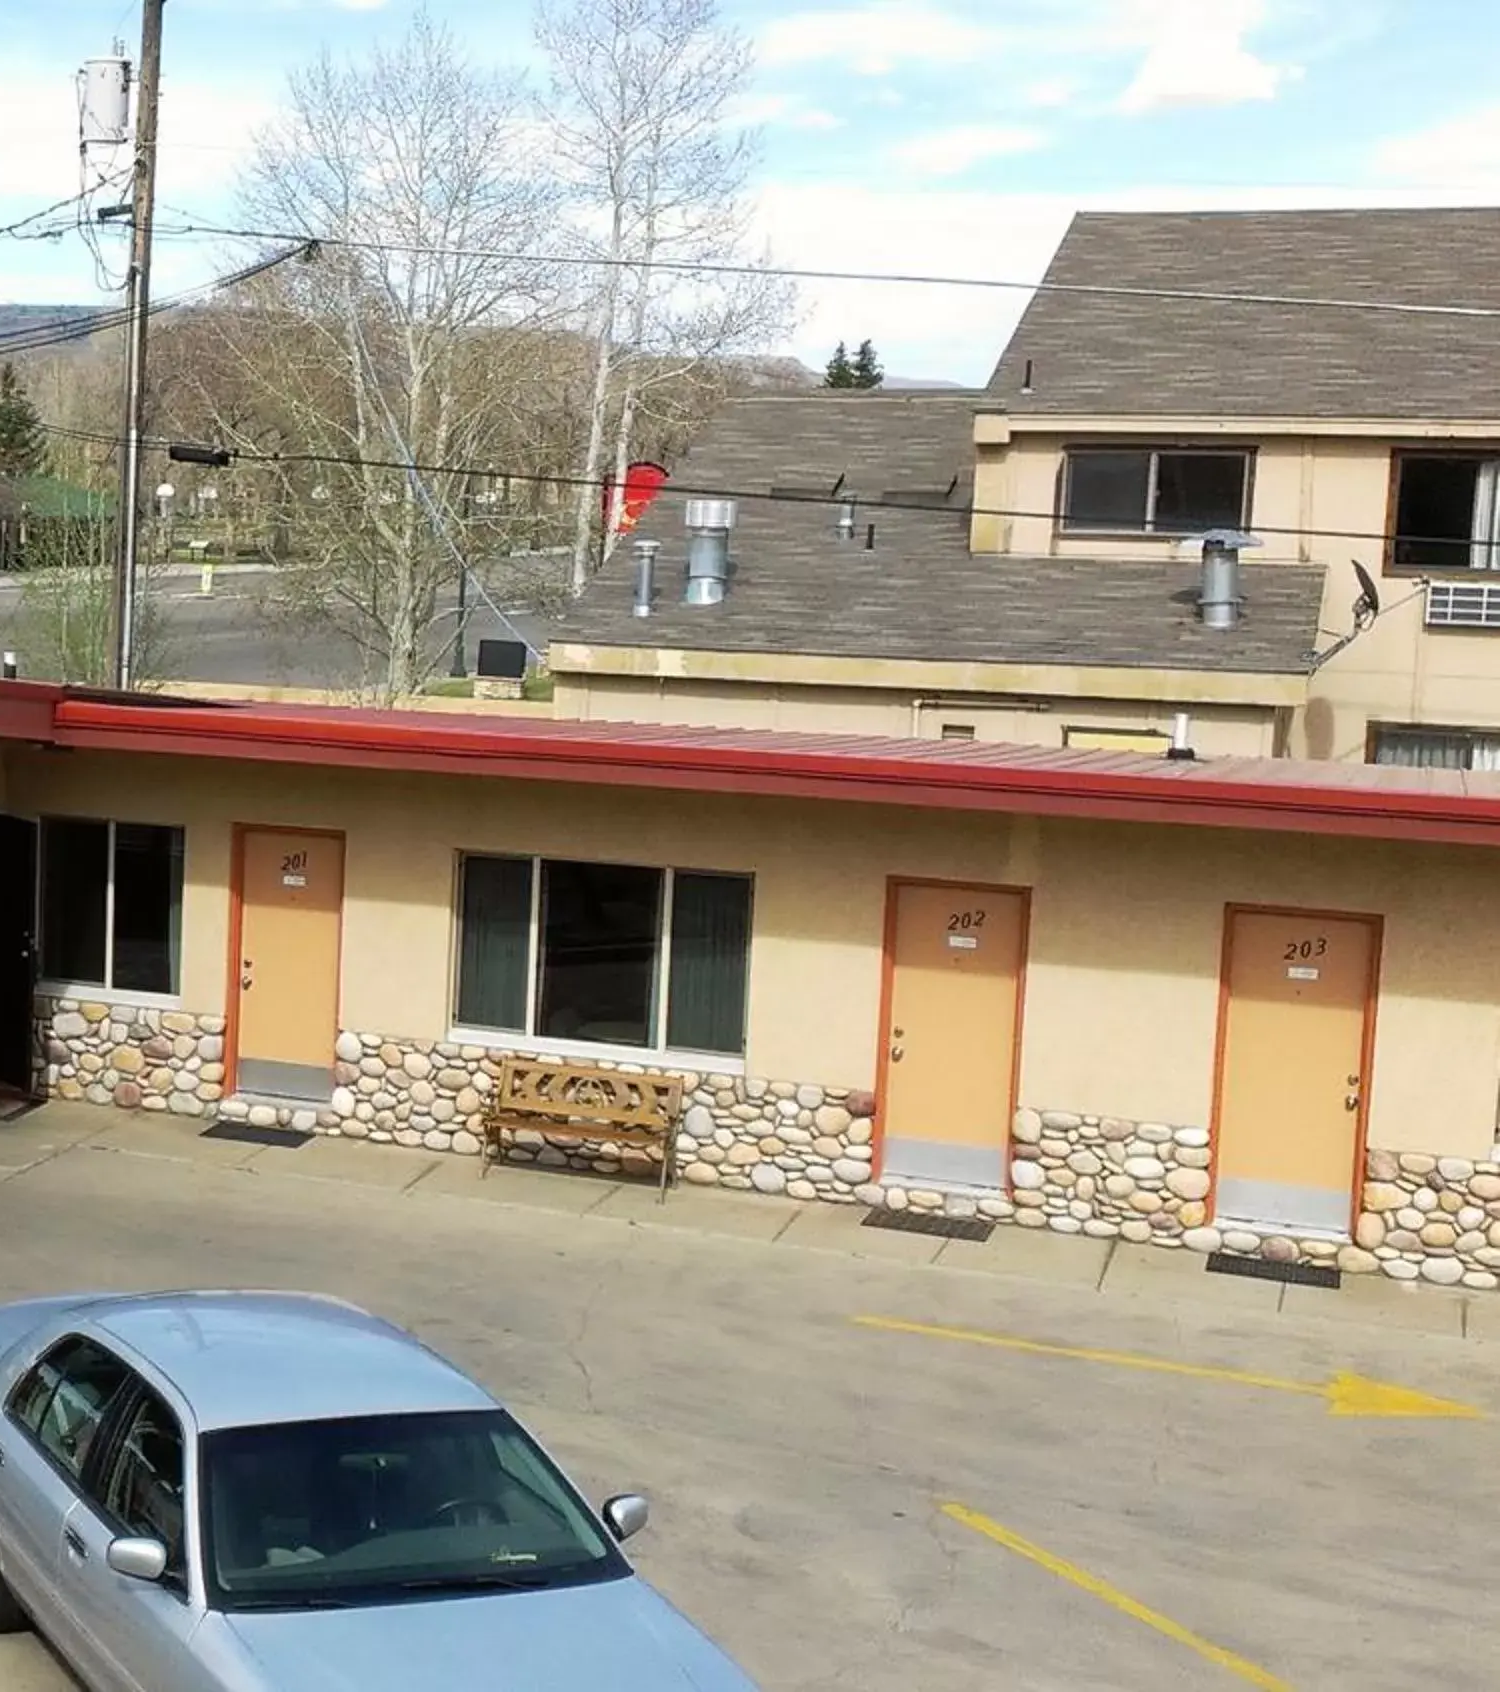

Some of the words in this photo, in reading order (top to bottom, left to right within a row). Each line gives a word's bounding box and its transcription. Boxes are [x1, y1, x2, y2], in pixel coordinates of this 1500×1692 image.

[280, 850, 307, 871] 201
[947, 909, 986, 931] 202
[1283, 937, 1327, 960] 203
